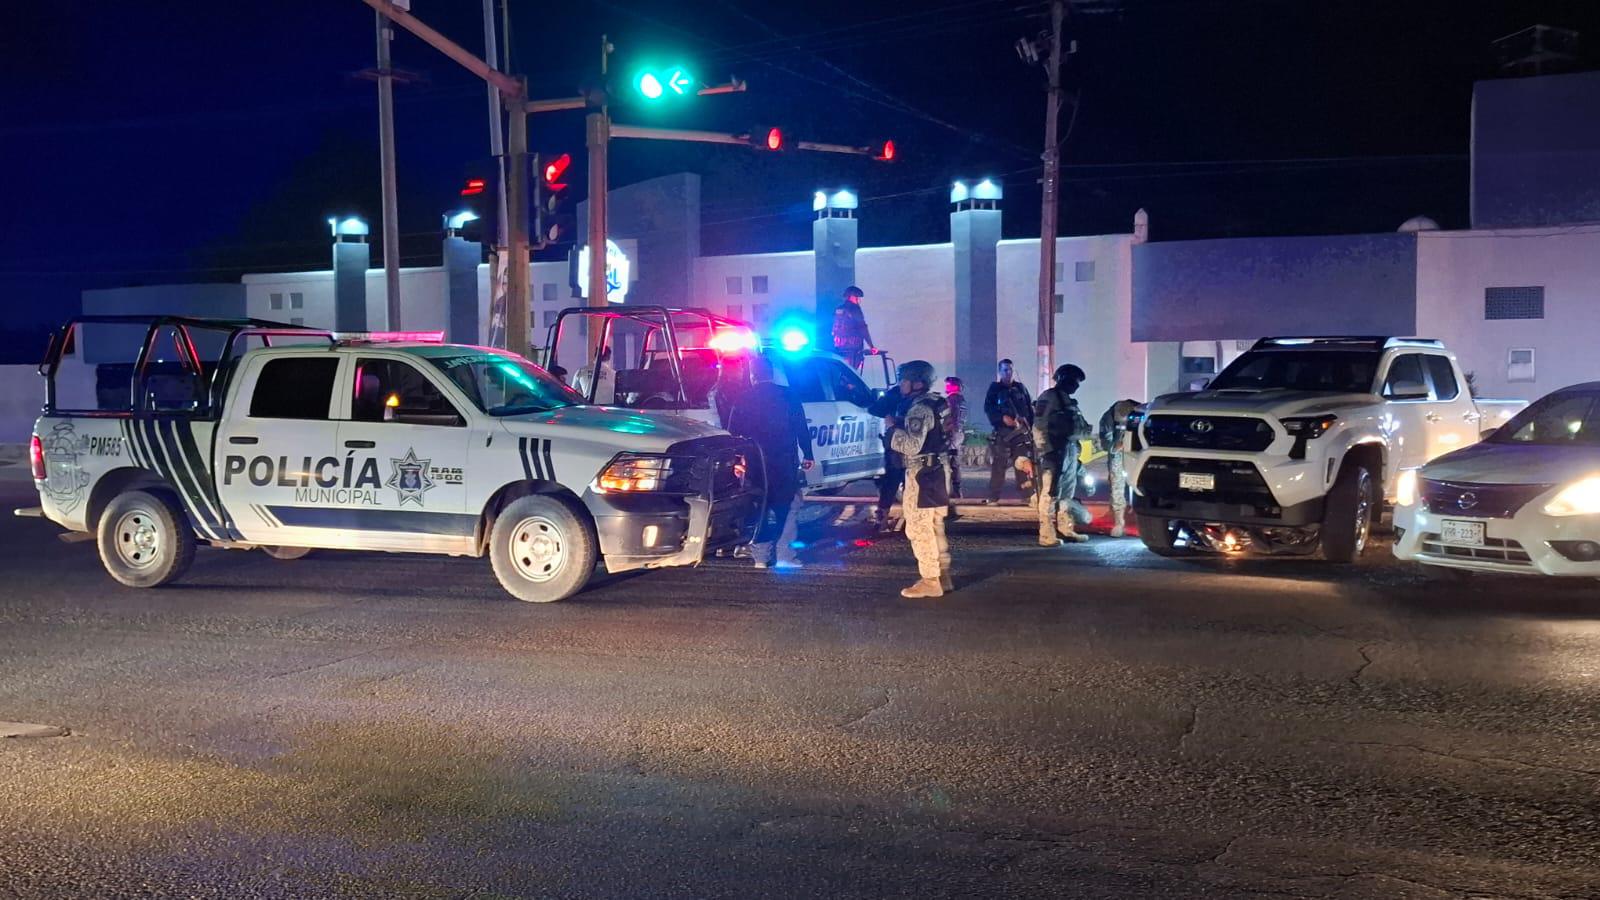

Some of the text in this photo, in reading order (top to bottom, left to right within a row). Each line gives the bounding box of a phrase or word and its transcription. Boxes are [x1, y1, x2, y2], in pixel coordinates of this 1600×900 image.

[831, 445, 863, 458] MUNICIPAL
[223, 450, 382, 489] POLICÍA
[430, 467, 464, 475] RAM
[295, 487, 382, 505] MUNICIPAL
